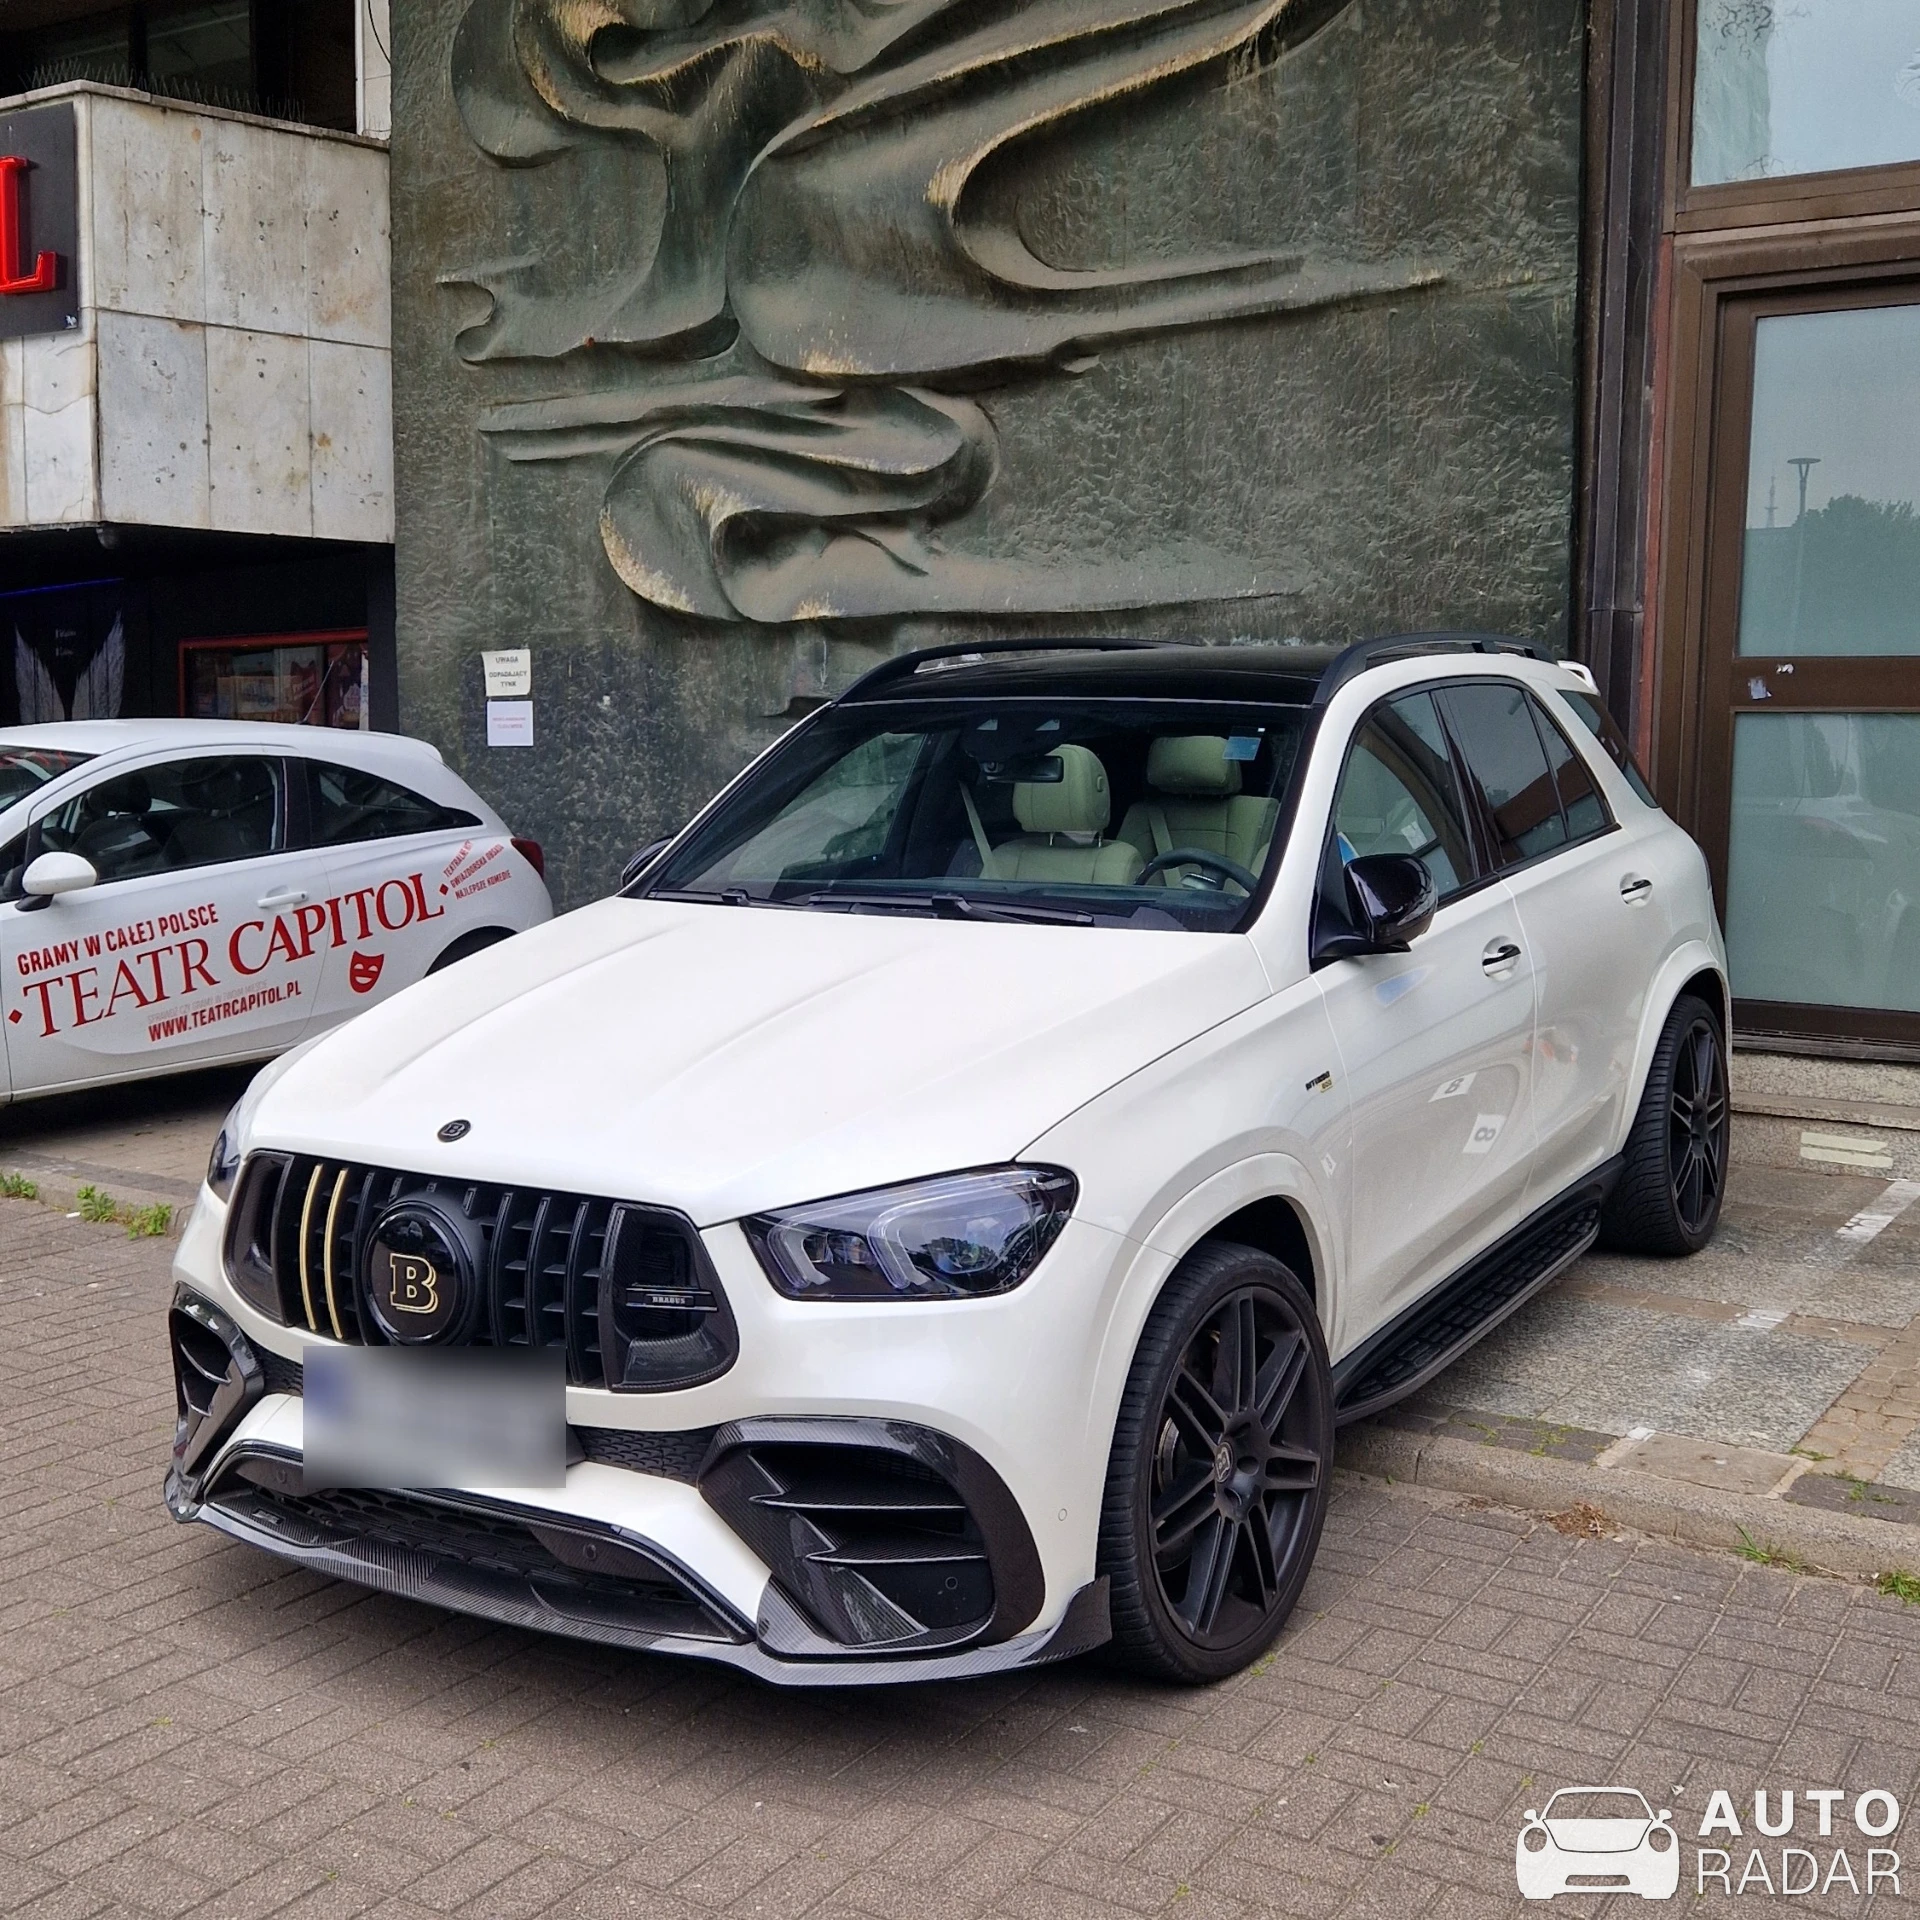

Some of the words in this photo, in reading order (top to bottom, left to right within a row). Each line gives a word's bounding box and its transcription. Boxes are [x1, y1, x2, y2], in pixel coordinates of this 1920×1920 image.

[495, 656, 519, 664] UWAGA
[455, 880, 487, 899] NAJLEPSZE
[17, 940, 80, 976] GRAMY
[84, 934, 101, 957] W
[105, 920, 155, 951] CAŁEJ
[158, 903, 219, 937] POLSCE
[23, 938, 221, 1038] TEATR
[229, 873, 445, 975] CAPITOL
[148, 980, 302, 1042] WWW.TEATRCAPITOL.PL
[441, 1122, 465, 1137] B
[389, 1252, 439, 1314] B
[652, 1296, 686, 1304] BRABUS
